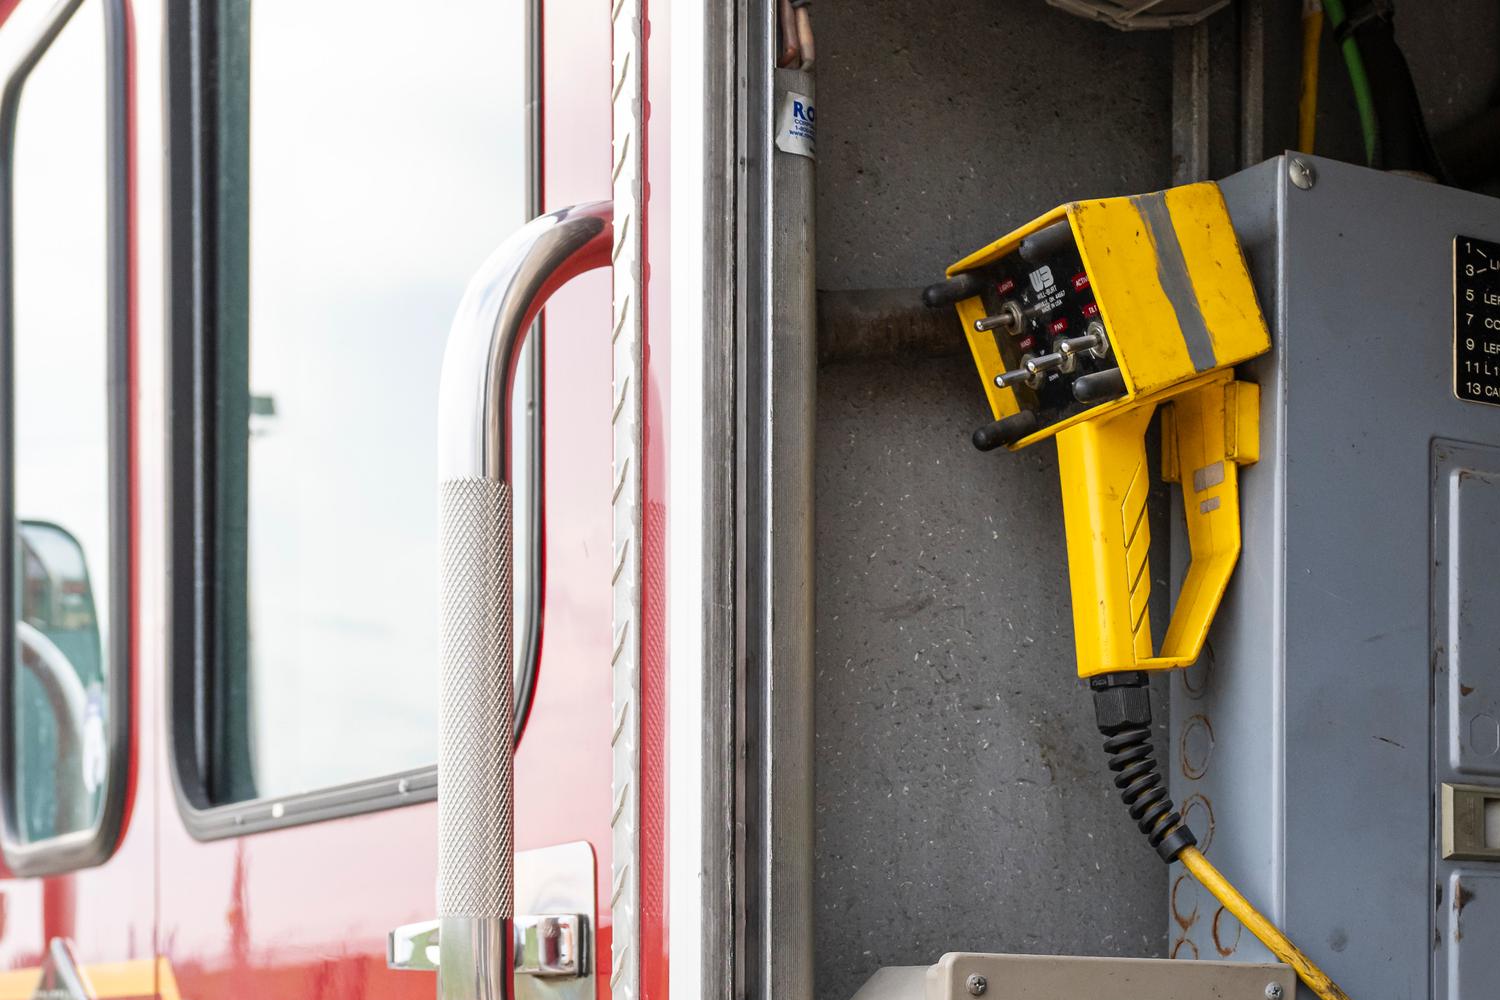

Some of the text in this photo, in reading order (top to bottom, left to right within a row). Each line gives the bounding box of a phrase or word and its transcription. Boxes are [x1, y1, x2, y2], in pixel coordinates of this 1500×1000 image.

[1466, 242, 1471, 254] 1
[1465, 264, 1474, 276] 3
[1465, 289, 1475, 301] 5
[1466, 312, 1474, 325] 7
[1054, 321, 1064, 331] PAN
[1466, 338, 1475, 351] 9
[1465, 361, 1479, 374] 11
[1466, 382, 1481, 395] 13
